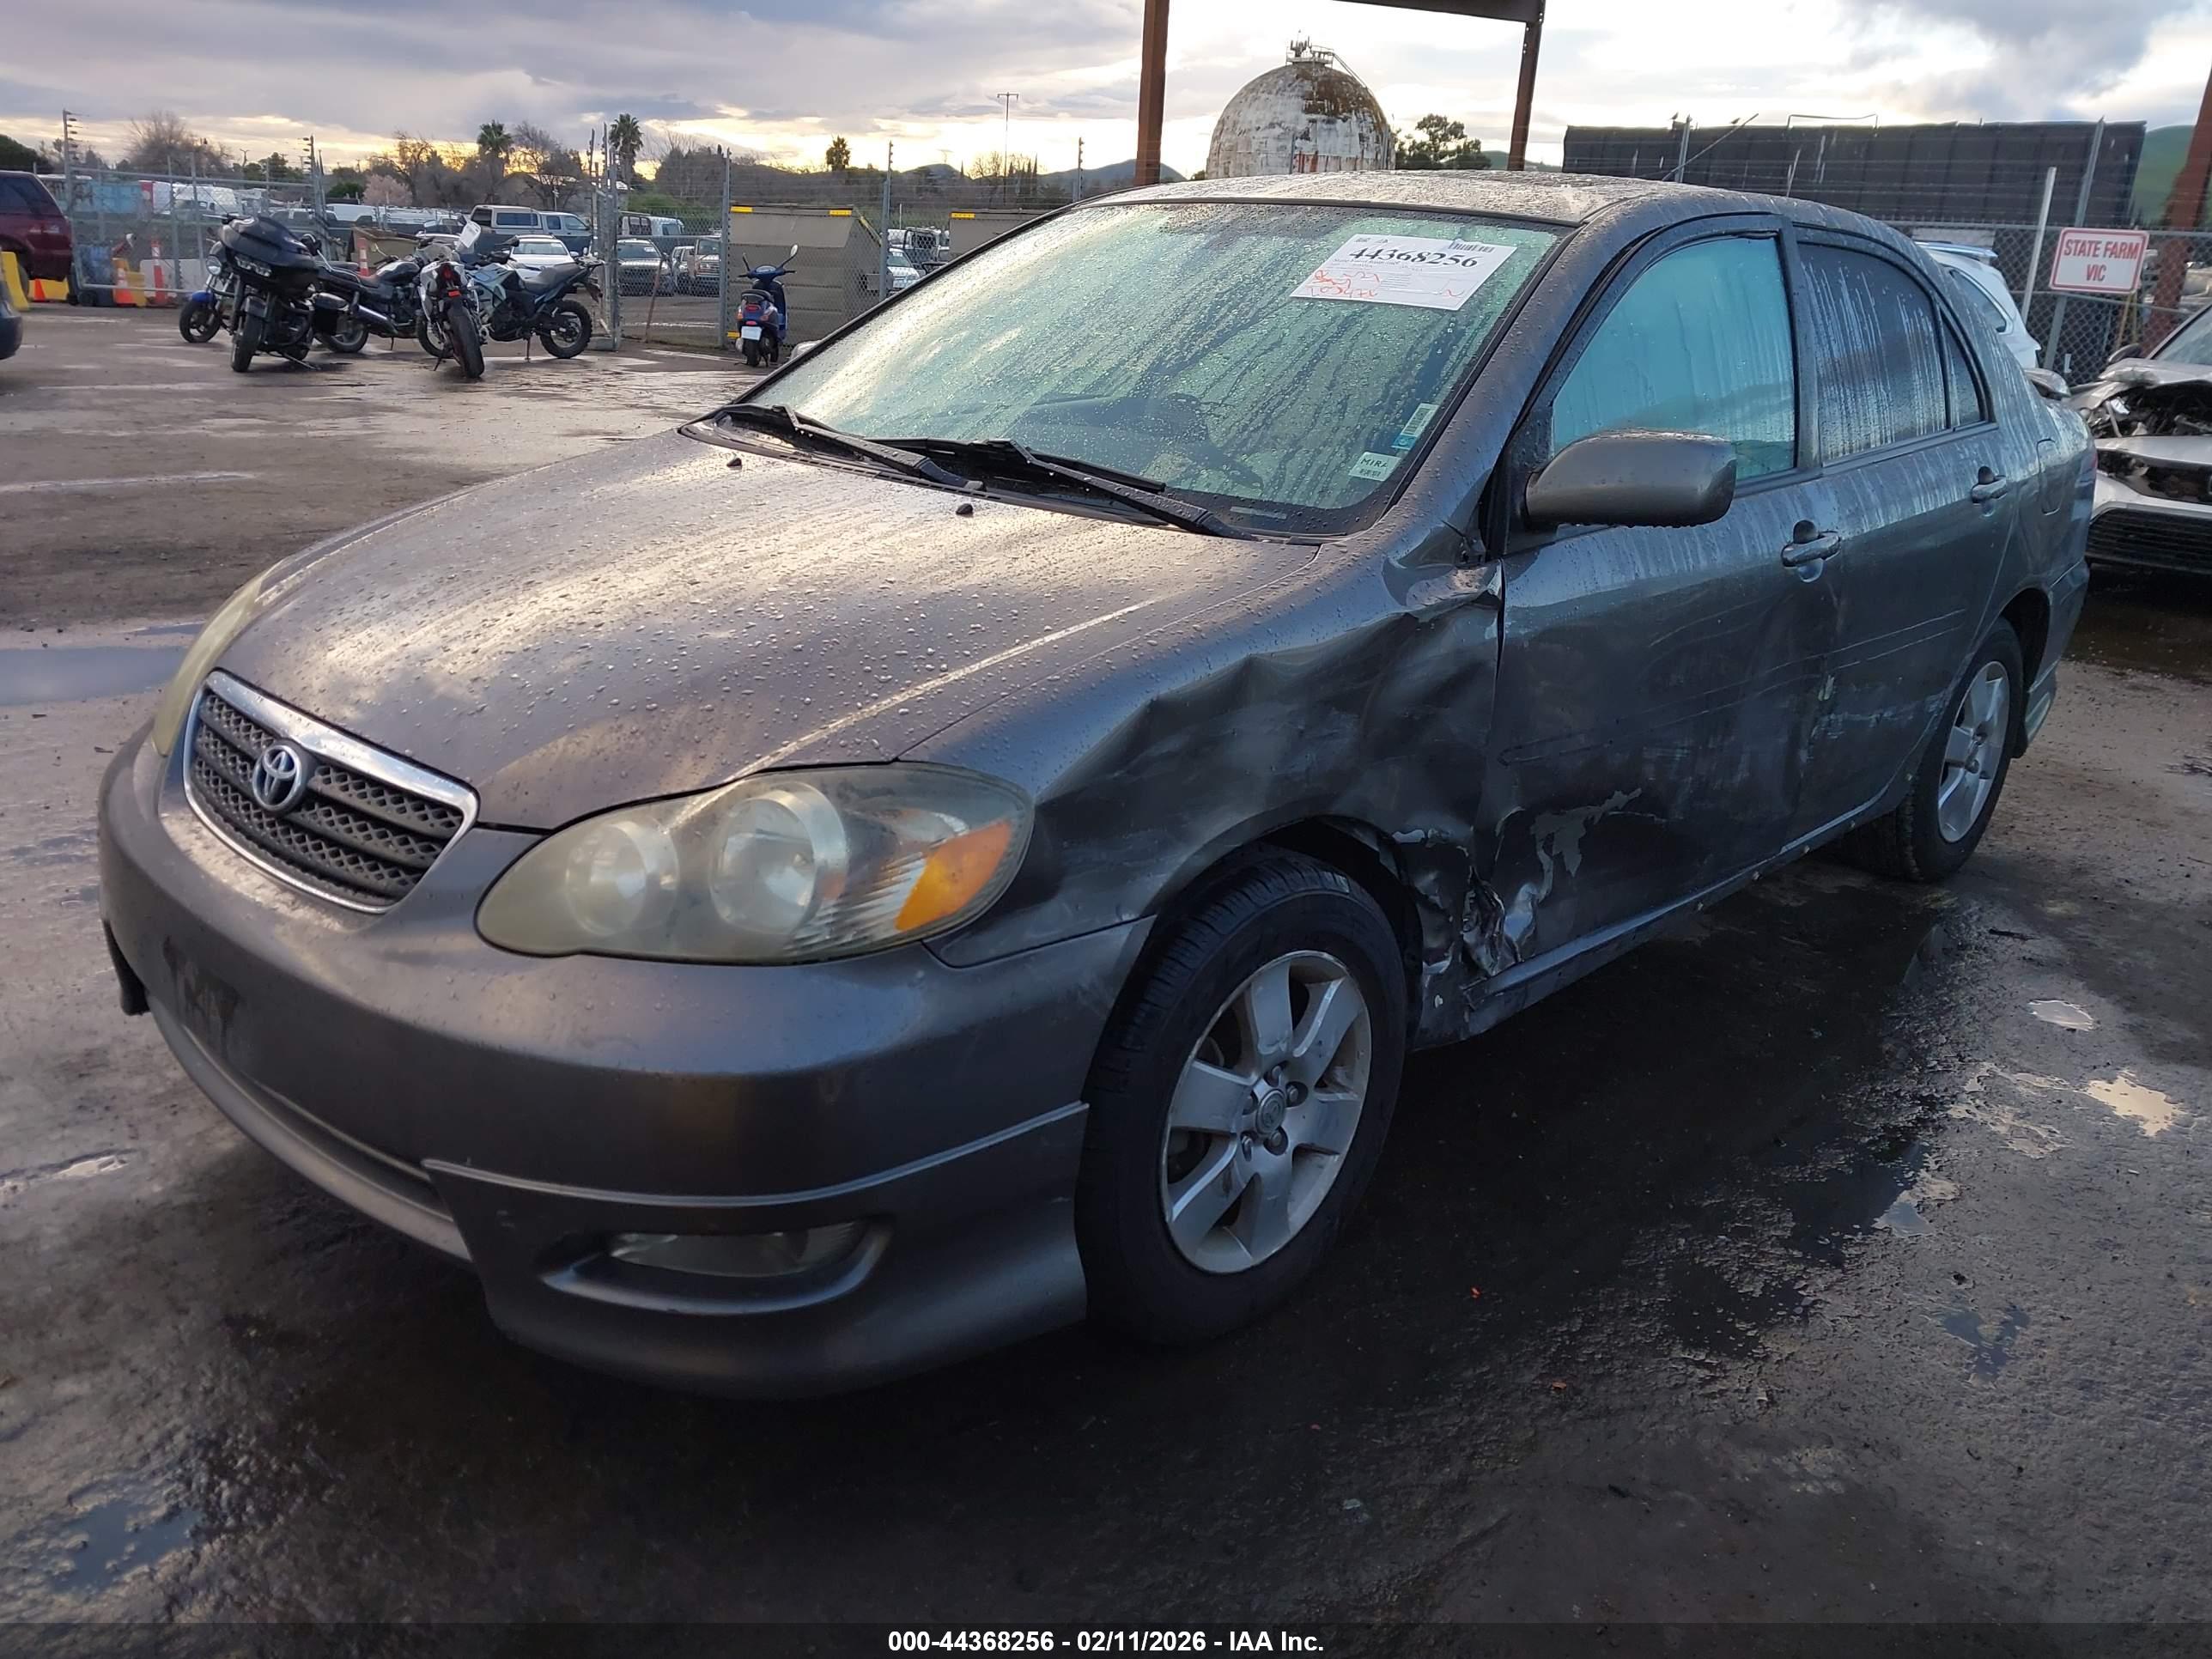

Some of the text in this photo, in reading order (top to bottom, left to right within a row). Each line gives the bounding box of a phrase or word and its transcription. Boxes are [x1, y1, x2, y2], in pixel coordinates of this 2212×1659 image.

[1349, 248, 1480, 267] 44368256
[2064, 239, 2140, 259] STATE FARM
[2086, 264, 2106, 281] VIC
